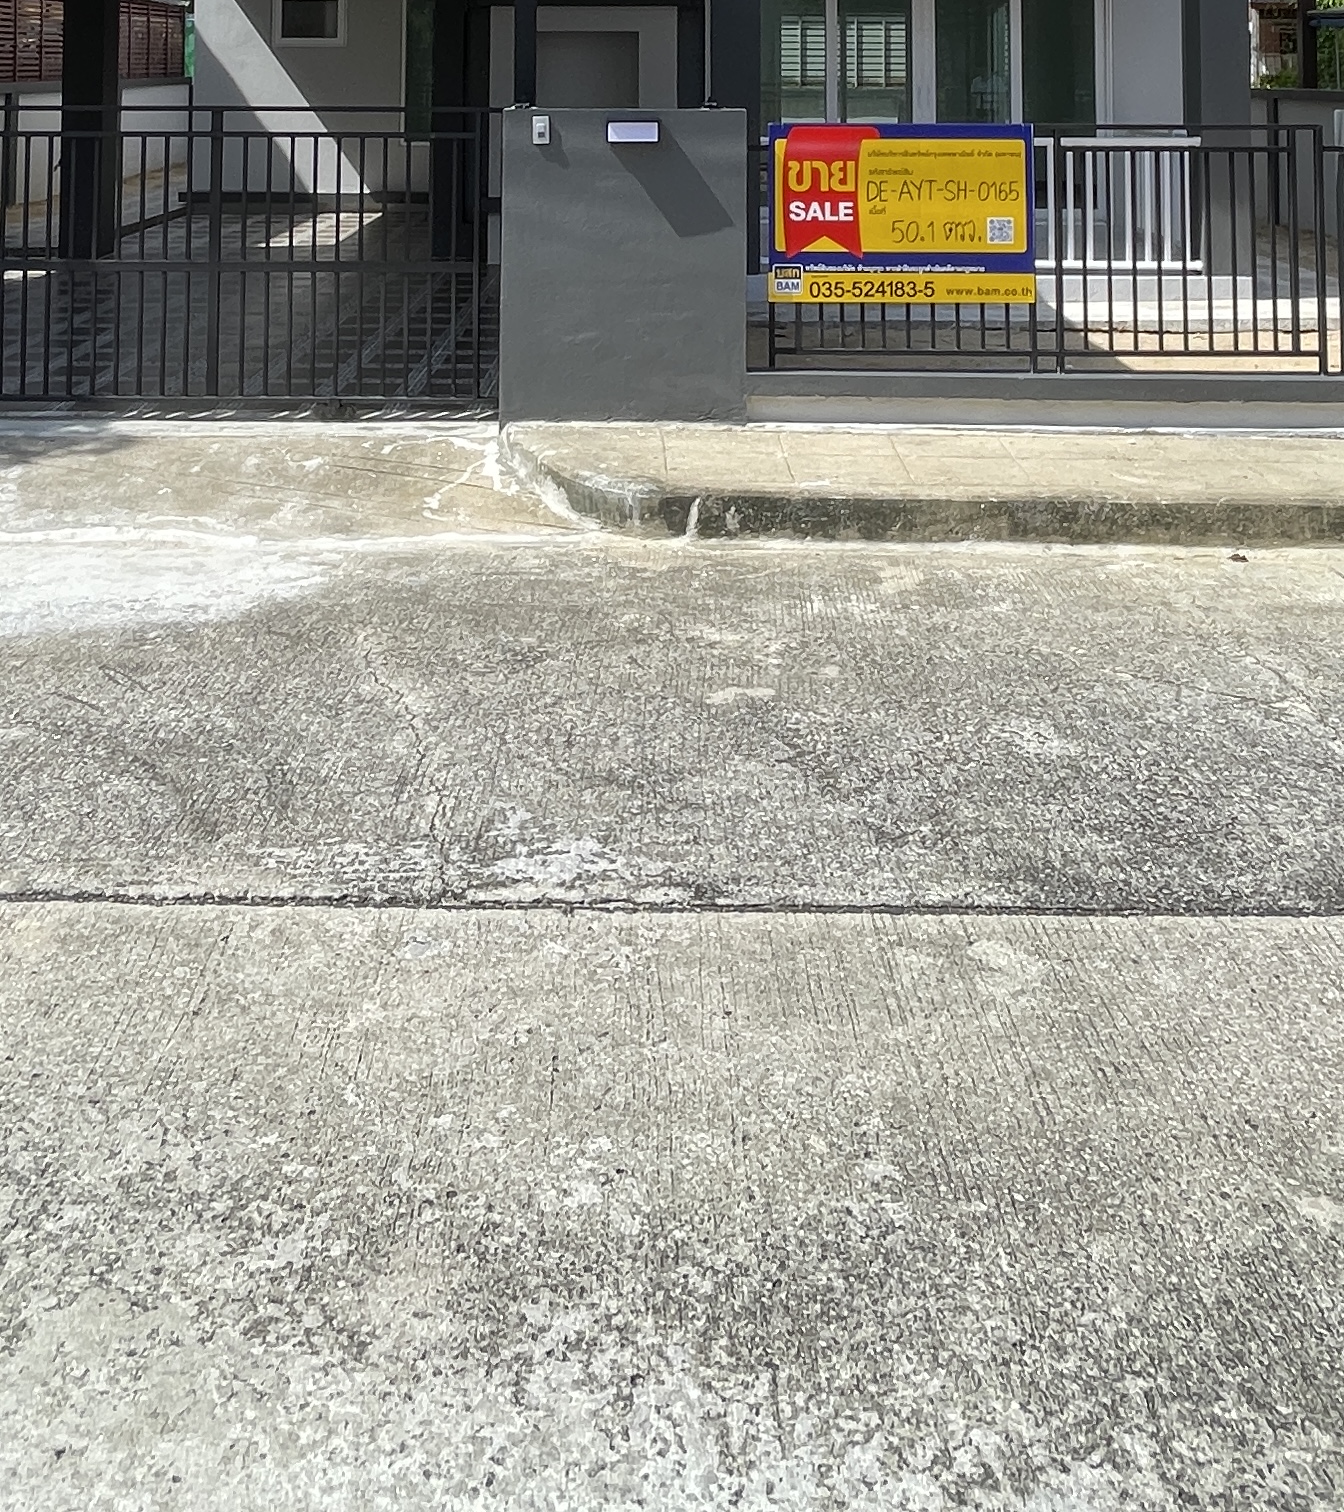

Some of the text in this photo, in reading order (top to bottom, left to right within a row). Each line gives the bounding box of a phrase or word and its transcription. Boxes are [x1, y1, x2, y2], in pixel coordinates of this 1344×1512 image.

[787, 160, 856, 193] ขาย
[866, 179, 1020, 202] DE-AYT-SH-0165
[788, 200, 855, 222] SALE
[891, 219, 935, 244] 50.1
[776, 280, 800, 292] BAM
[809, 280, 1033, 299] 035-524183-5 www.bam.co.th
